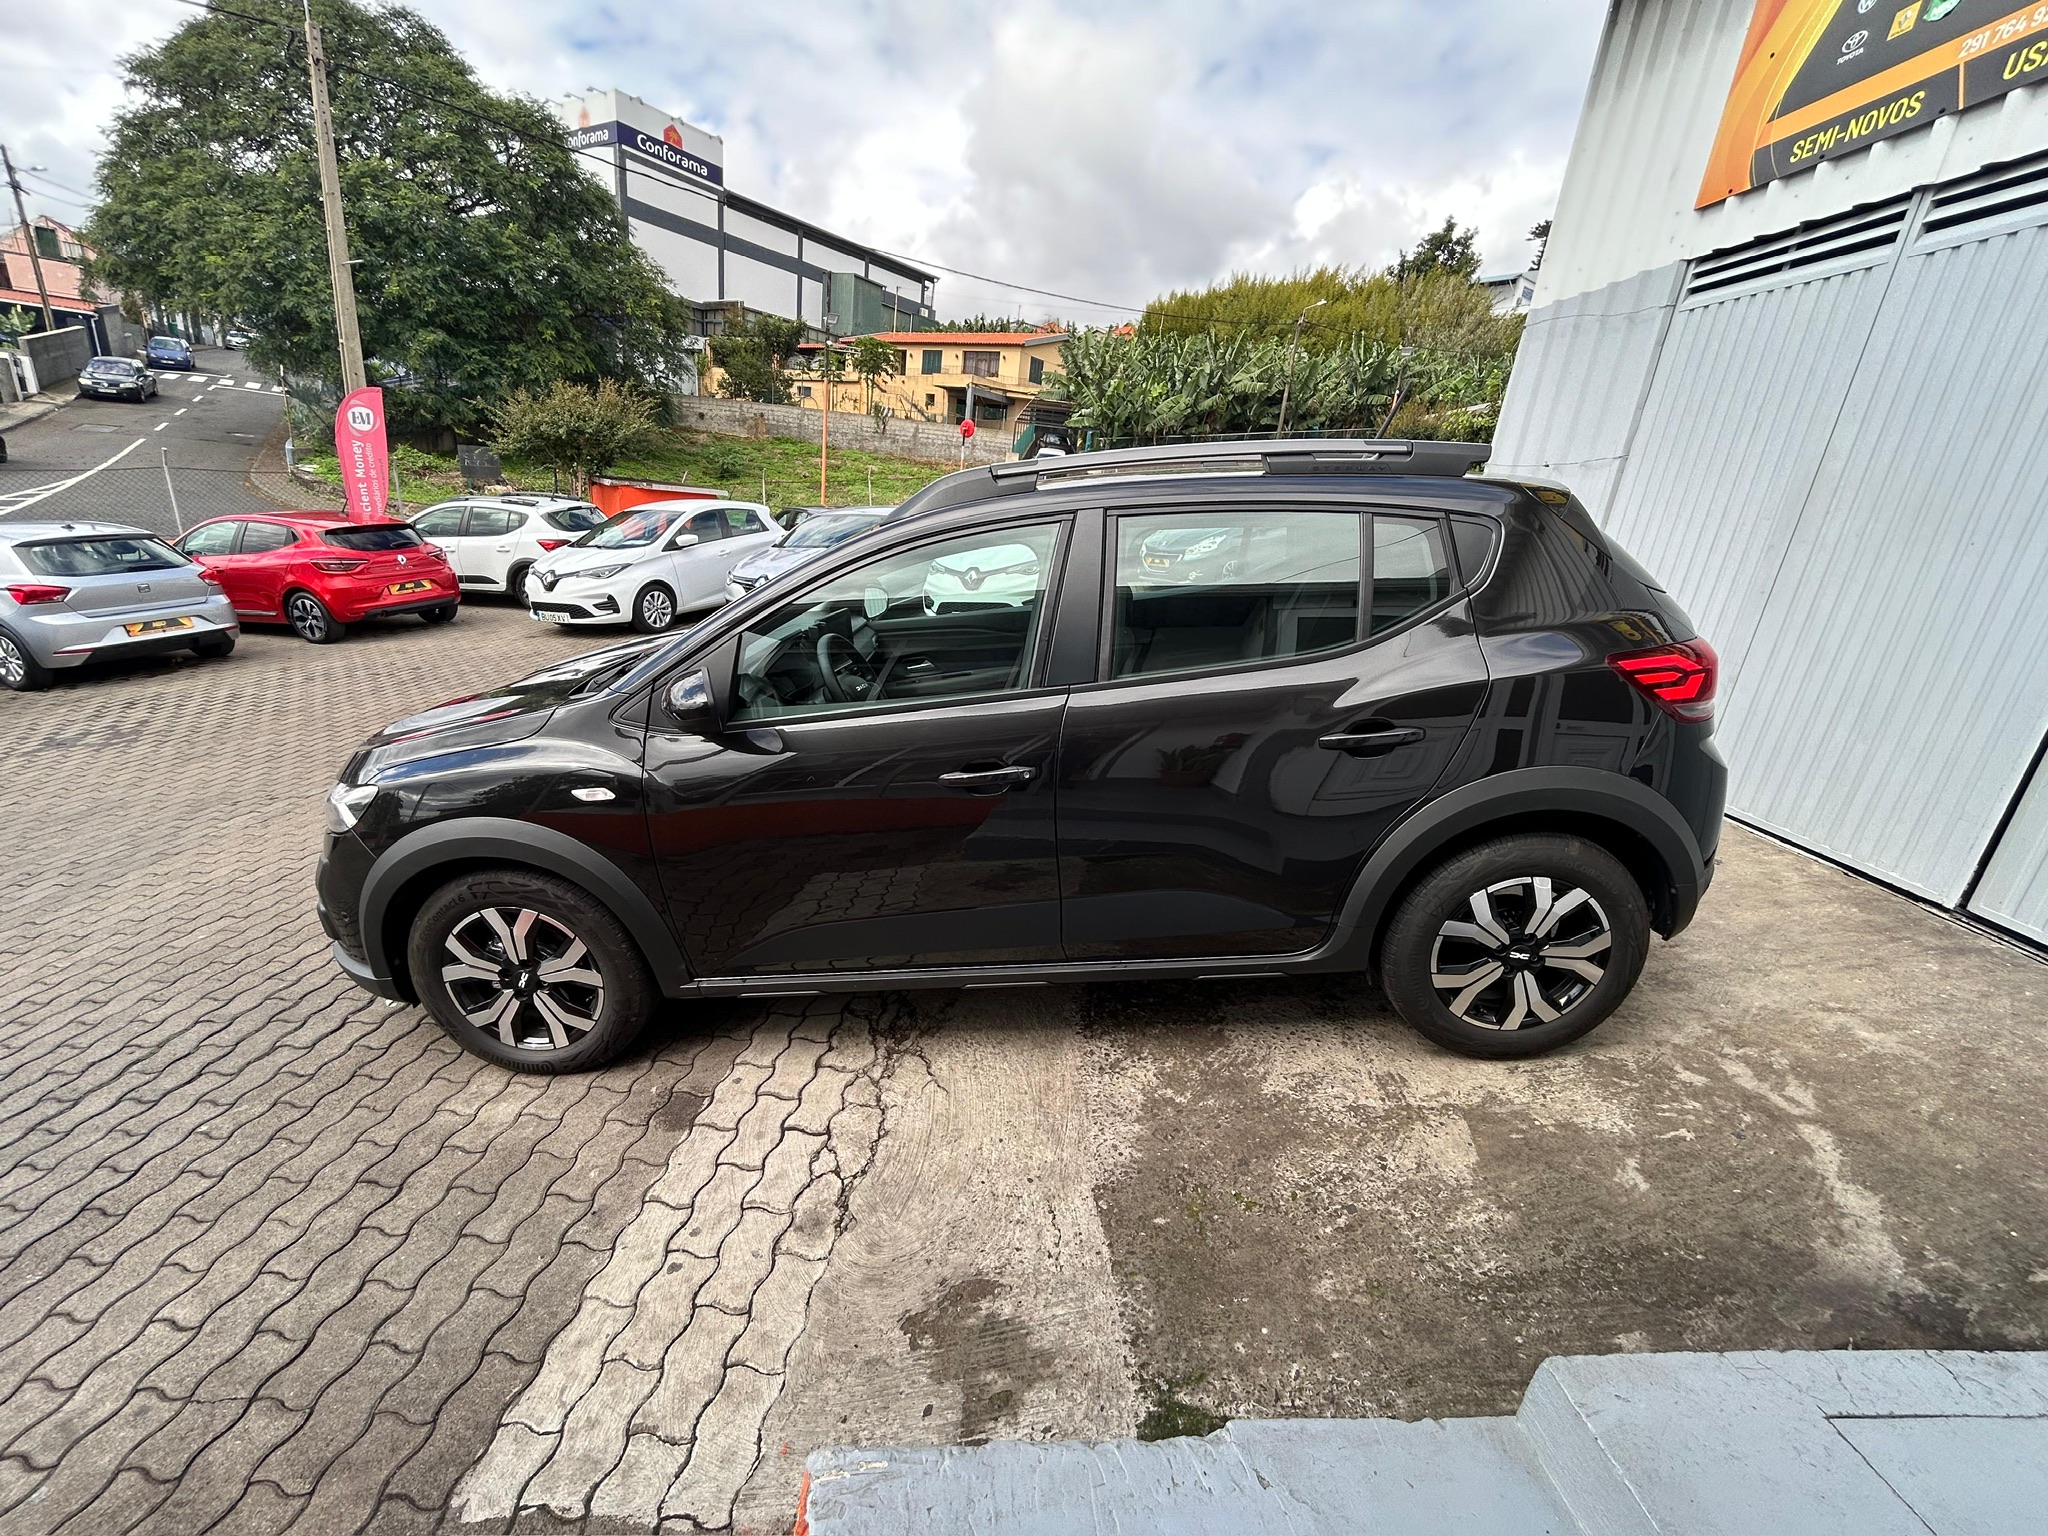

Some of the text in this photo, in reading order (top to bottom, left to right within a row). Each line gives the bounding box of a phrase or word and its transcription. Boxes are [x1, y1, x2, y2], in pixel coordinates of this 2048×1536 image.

[1957, 30, 1991, 59] 291
[1992, 15, 2027, 44] 764
[565, 128, 609, 149] onforama
[1789, 91, 1927, 163] SEMI-NOVOS
[636, 133, 708, 177] Conforama
[352, 440, 372, 514] cient Money
[366, 443, 376, 468] crédito
[369, 469, 377, 478] de
[372, 480, 384, 516] rmediários
[418, 892, 466, 940] EcoContact 6
